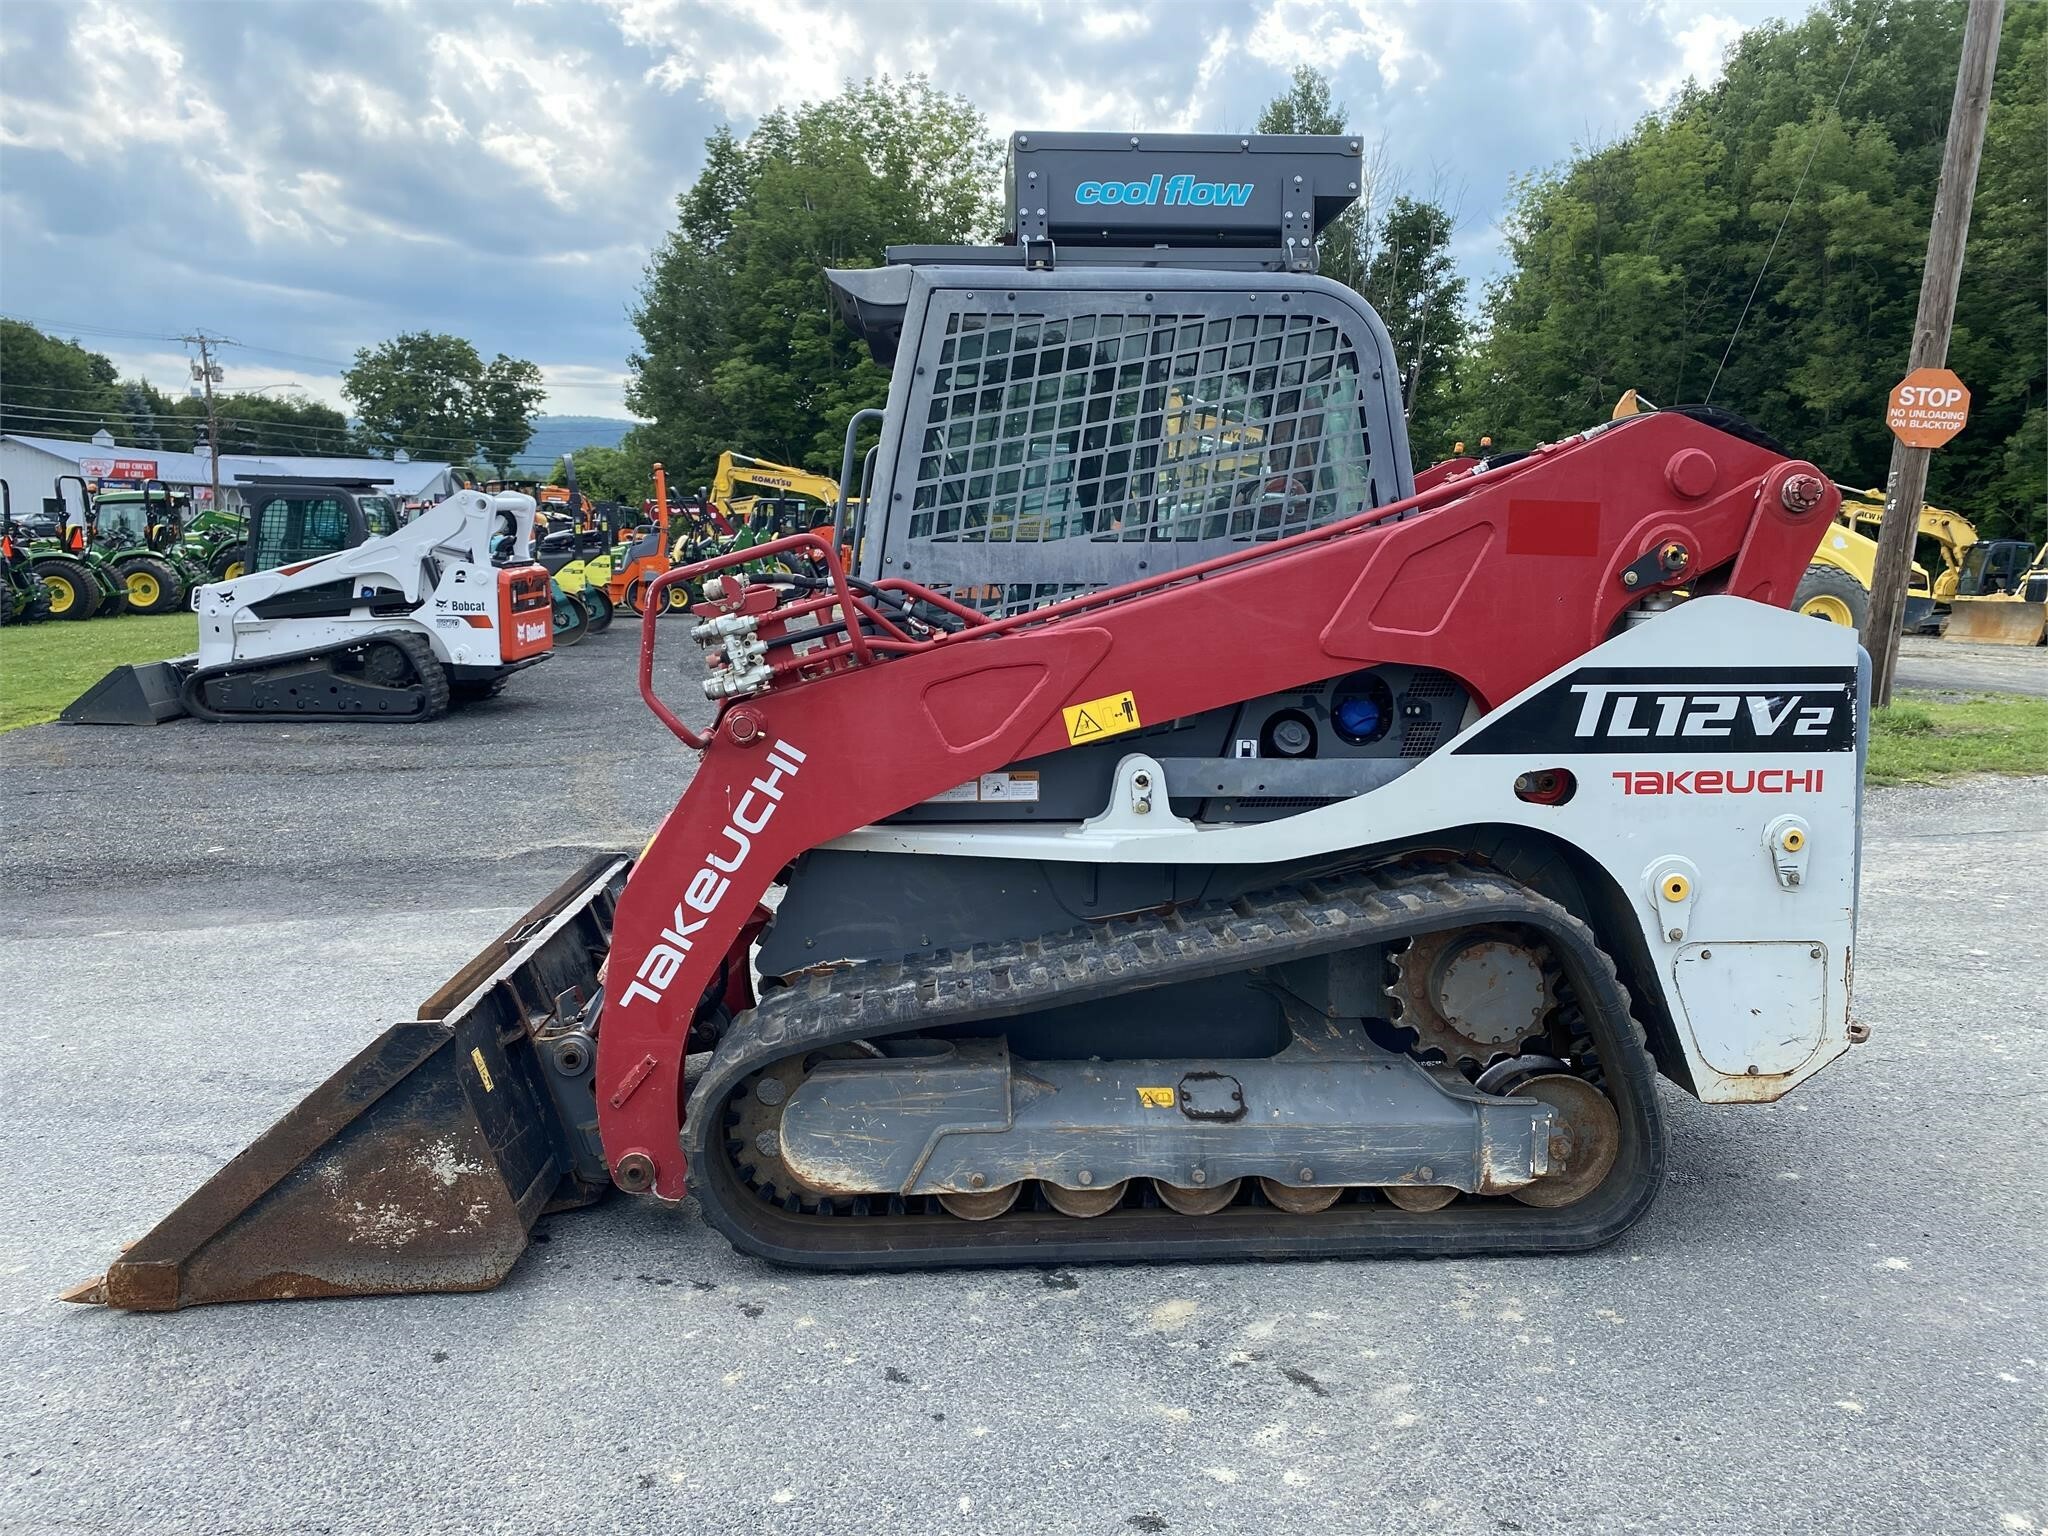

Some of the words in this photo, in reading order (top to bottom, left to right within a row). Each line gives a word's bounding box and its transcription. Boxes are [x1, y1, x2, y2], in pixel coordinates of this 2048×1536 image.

[1075, 174, 1163, 205] cool
[1163, 174, 1254, 206] flow
[1898, 386, 1962, 407] STOP
[1890, 408, 1905, 417] NO
[1909, 409, 1965, 420] UNLOADING
[1891, 418, 1906, 427] ON
[1909, 419, 1961, 430] BLACKTOP
[752, 475, 792, 488] KOMATSU
[452, 601, 485, 611] Bobcat
[436, 618, 460, 628] T870
[526, 621, 546, 642] Bobcat
